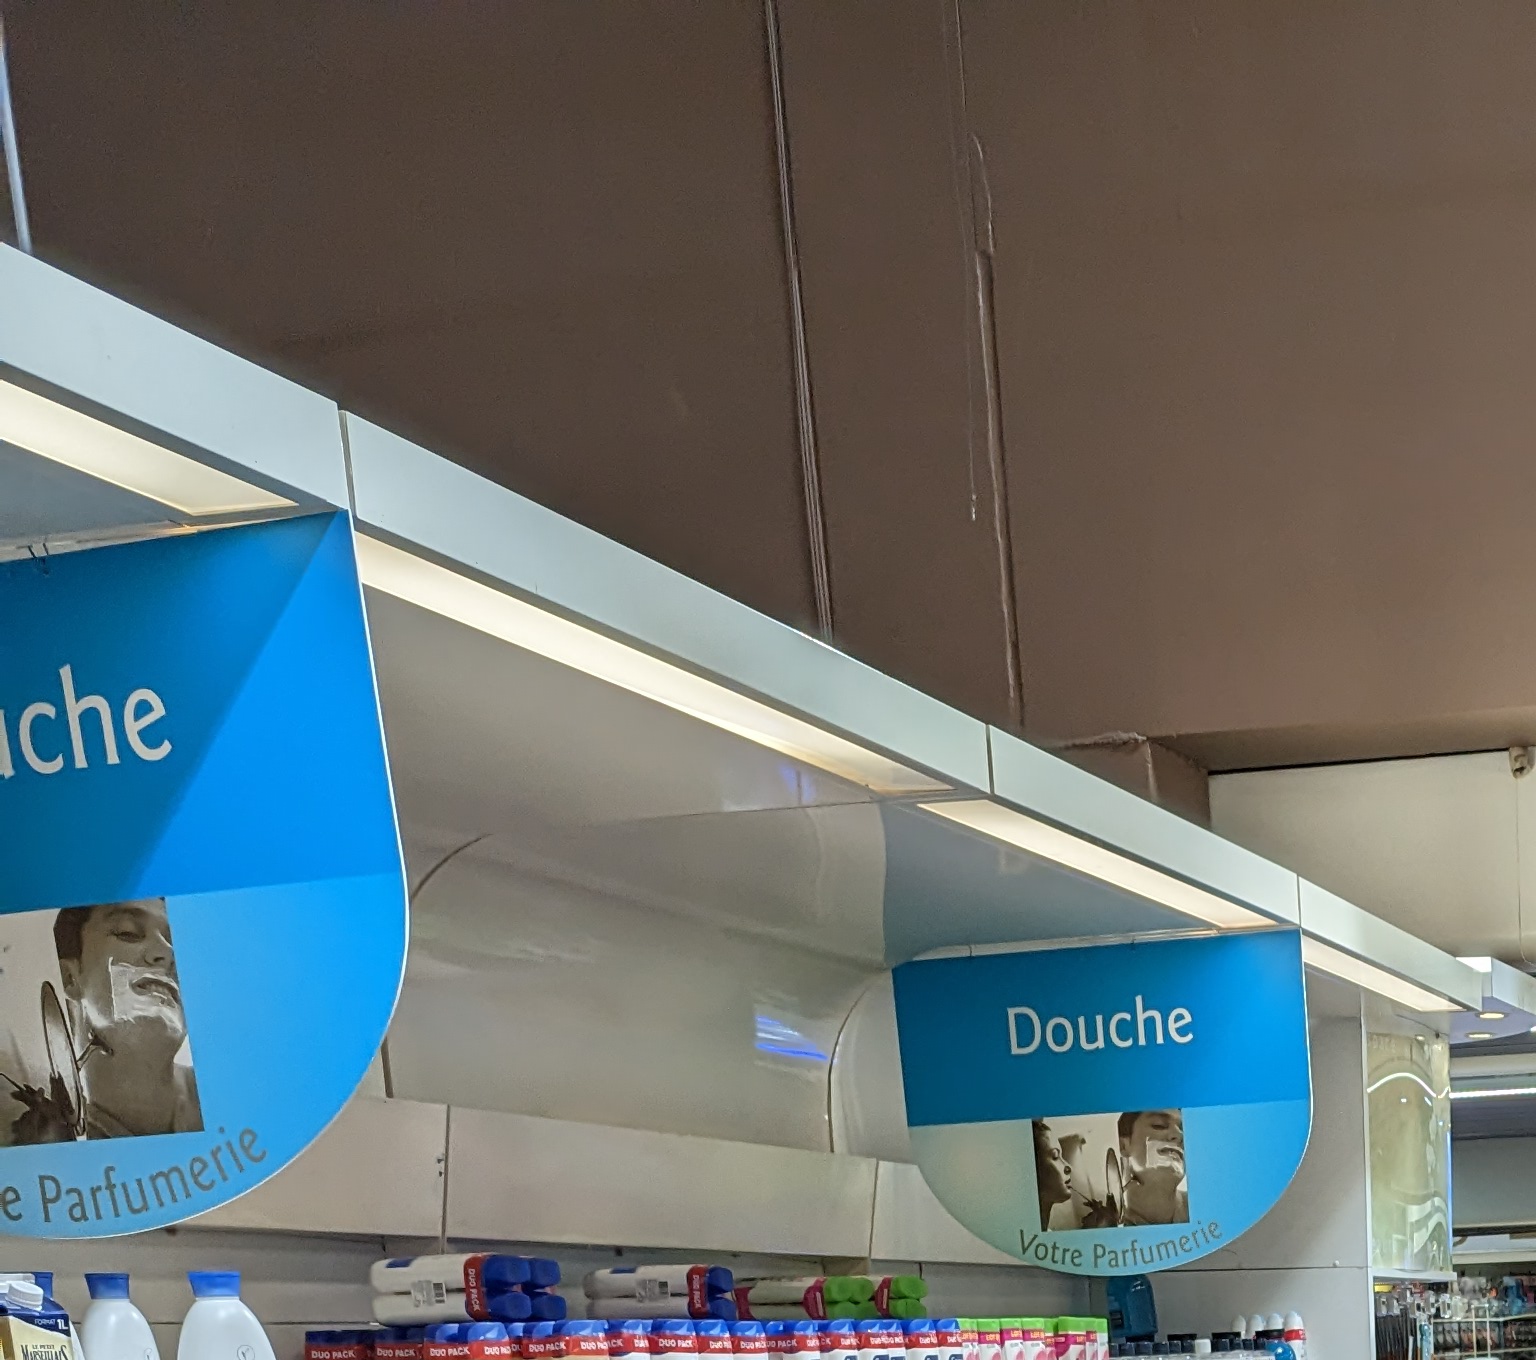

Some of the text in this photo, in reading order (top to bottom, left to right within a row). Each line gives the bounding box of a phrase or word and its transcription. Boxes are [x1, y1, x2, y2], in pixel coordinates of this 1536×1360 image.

[1007, 995, 1194, 1055] Douche
[38, 1126, 267, 1223] Parfumerie
[1019, 1220, 1223, 1269] Votre Parfumerie
[468, 1268, 480, 1312] DUO PACK
[57, 1319, 69, 1330] 1L
[528, 1343, 544, 1352] DUO
[659, 1339, 676, 1348] DUO
[311, 1350, 356, 1359] DUO PACK
[376, 1348, 415, 1358] DUO PACK
[429, 1346, 470, 1357] DUO PACK
